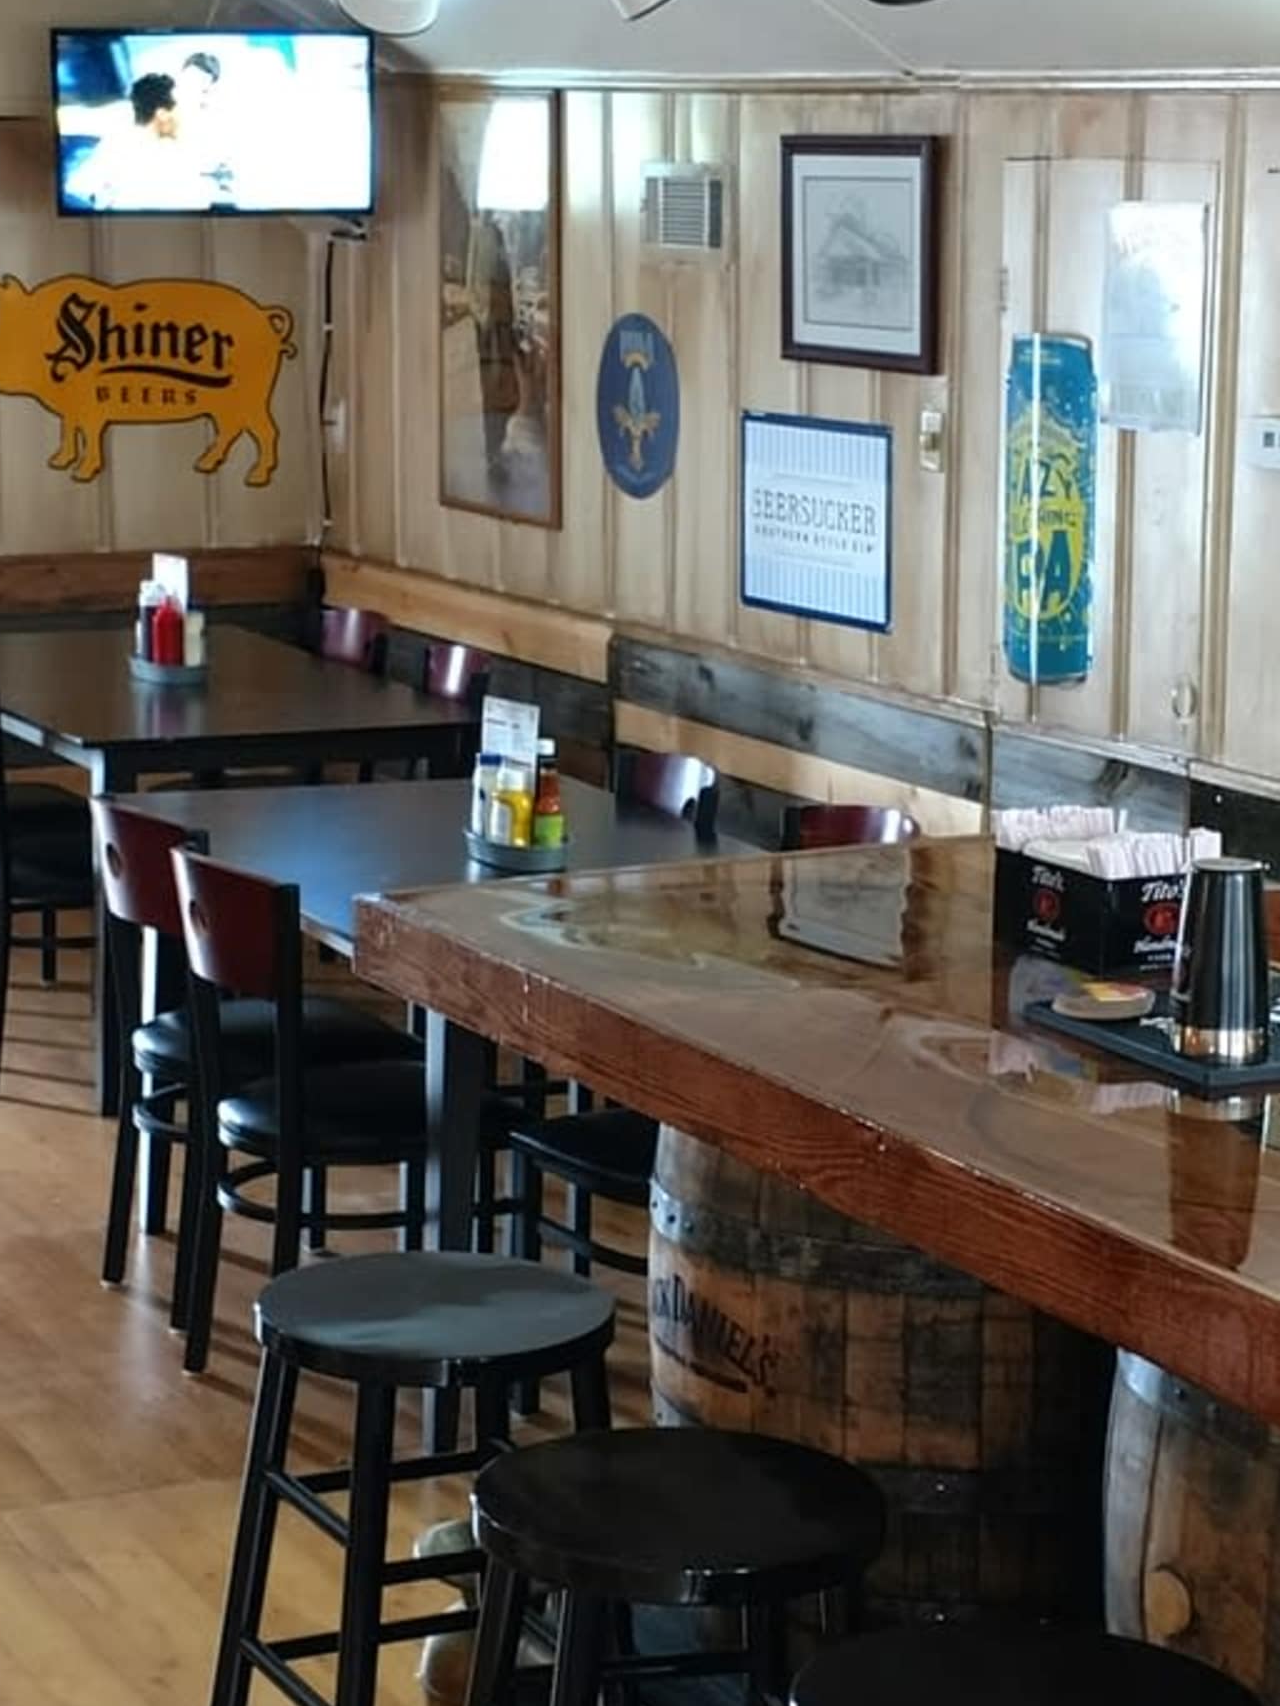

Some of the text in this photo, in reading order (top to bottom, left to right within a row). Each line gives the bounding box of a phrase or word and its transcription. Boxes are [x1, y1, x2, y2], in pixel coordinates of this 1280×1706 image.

[43, 292, 235, 383] Shiner
[95, 385, 198, 405] BEERS
[752, 488, 876, 536] SEERSUCKER
